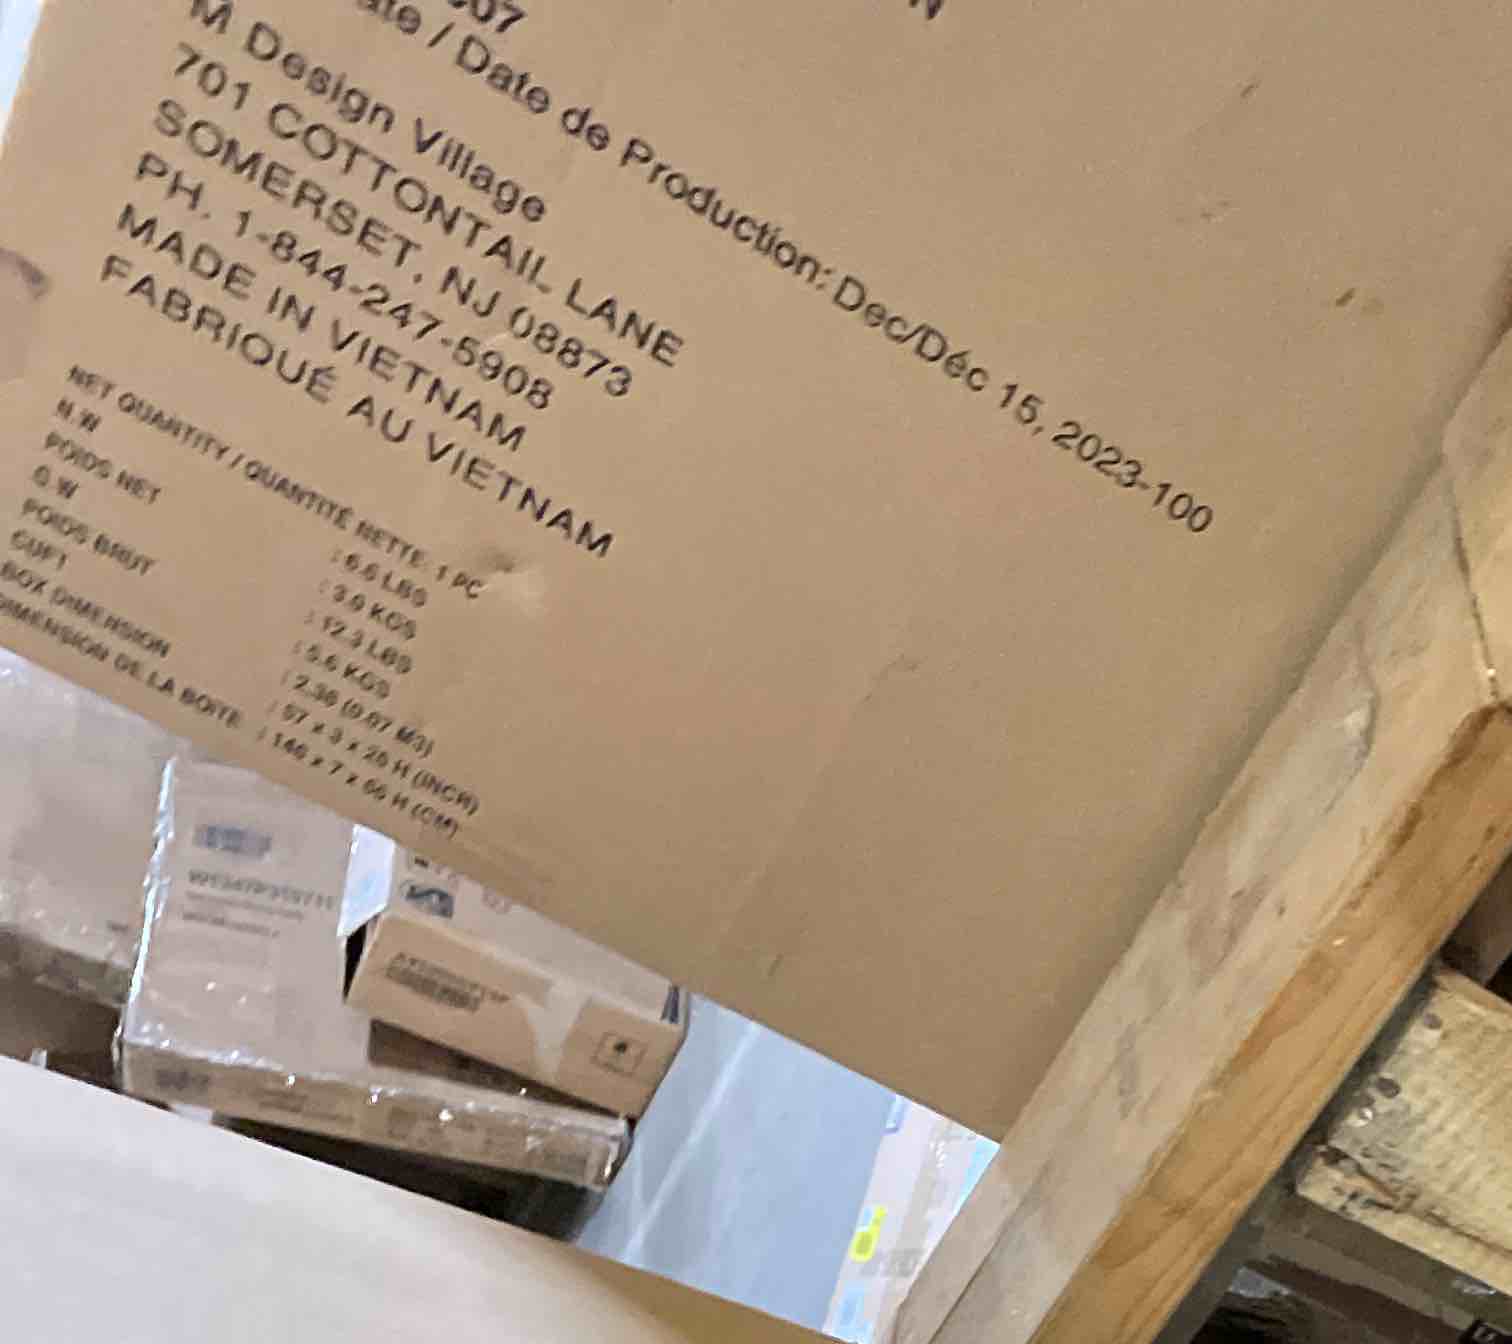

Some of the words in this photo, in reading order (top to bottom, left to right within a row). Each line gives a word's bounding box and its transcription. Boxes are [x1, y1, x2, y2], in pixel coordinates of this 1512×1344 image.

[174, 42, 252, 111] 701
[267, 103, 551, 296] COTTONTAIL
[565, 277, 687, 367] LANE
[245, 21, 396, 135] Design
[413, 116, 547, 223] Village
[117, 202, 257, 300] MADE
[267, 284, 313, 332] IN
[331, 319, 527, 453] VIETNAM
[135, 151, 211, 220] PH.
[233, 211, 556, 410] 1-844-247-5908
[439, 265, 501, 318] NJ
[508, 305, 634, 398] 08873
[455, 34, 550, 114] Date
[560, 105, 611, 151] de
[619, 137, 834, 290] Production:
[999, 382, 1044, 436] 15,
[1051, 421, 1214, 533] 2023-100
[43, 432, 112, 477] POIDS
[116, 469, 162, 503] NET
[68, 365, 115, 402] NET
[117, 391, 232, 464] QUANTITY
[243, 459, 355, 533] QUANTITÉ
[450, 572, 484, 600] PC
[101, 254, 341, 404] FABRIQUÉ
[347, 395, 415, 444] AU
[426, 431, 615, 559] VIETNAM
[21, 498, 90, 544] POIDS
[92, 533, 157, 577] BRUT
[50, 586, 171, 659] DIMENSION
[113, 651, 143, 678] DE
[145, 671, 175, 696] LA
